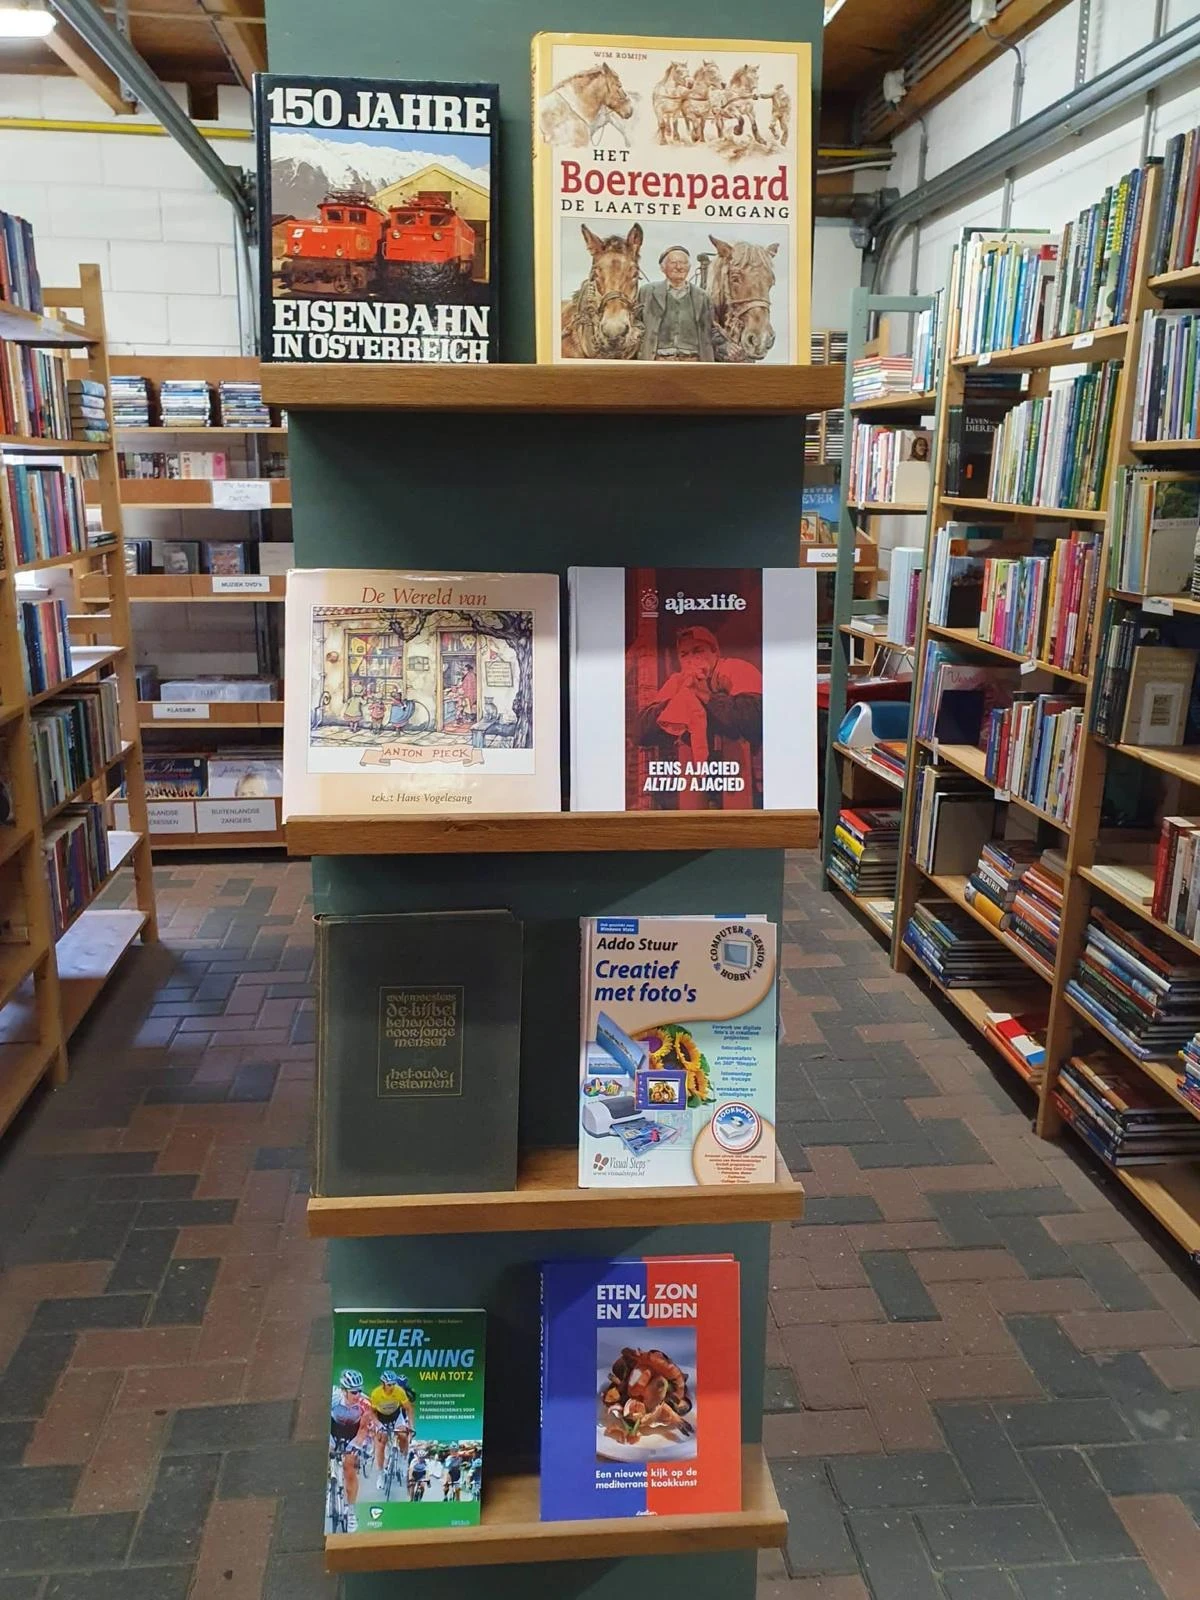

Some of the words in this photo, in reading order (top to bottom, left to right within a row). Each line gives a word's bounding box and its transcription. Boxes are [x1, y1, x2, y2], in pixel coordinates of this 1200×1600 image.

[594, 51, 613, 59] WIM
[616, 52, 648, 61] ROMIJN
[267, 87, 342, 127] 150
[348, 91, 490, 134] JAHRE
[593, 150, 630, 162] HET
[560, 160, 789, 210] Boerenpaard
[561, 199, 584, 212] DE
[595, 200, 682, 215] LAATSTE
[704, 204, 790, 218] OMGANG
[272, 300, 491, 337] EISENBAHN
[272, 333, 304, 358] IN
[308, 332, 489, 363] ÖSTERREICH
[362, 587, 385, 604] De
[393, 588, 452, 606] Wereld
[459, 594, 488, 606] van
[665, 592, 746, 614] ajaxlife
[383, 748, 423, 758] ANTON
[432, 748, 469, 759] PIECK
[648, 761, 682, 776] EENS
[685, 761, 740, 776] AJACIED
[643, 778, 687, 792] ALTIJD
[690, 778, 745, 792] AJACIED
[396, 792, 420, 803] Hans
[424, 792, 473, 805] Vogelesang
[744, 928, 752, 937] &
[597, 937, 635, 950] Addo
[639, 938, 678, 952] Stuur
[711, 925, 744, 962] COMPUTER
[751, 934, 765, 968] SENIOR
[596, 960, 680, 979] Creatief
[720, 969, 752, 981] HOBBY
[595, 984, 636, 1002] met
[640, 983, 697, 1002] foto's
[394, 1036, 448, 1048] mensen
[386, 1072, 454, 1089] testament
[610, 1157, 628, 1169] Visual
[630, 1157, 646, 1172] Steps
[596, 1284, 646, 1302] ETEN,
[654, 1284, 698, 1300] ZON
[596, 1304, 622, 1320] EN
[628, 1303, 698, 1320] ZUIDEN
[348, 1328, 430, 1347] WIELER-
[376, 1349, 476, 1368] TRAINING
[420, 1371, 439, 1381] VAN
[441, 1371, 447, 1381] A
[449, 1371, 465, 1381] TOT
[466, 1371, 474, 1381] Z
[596, 1470, 612, 1478] Een
[614, 1470, 648, 1478] nieuwe
[651, 1468, 668, 1478] kijk
[672, 1470, 683, 1479] op
[686, 1468, 698, 1476] de
[596, 1480, 648, 1489] mediterrane
[651, 1478, 698, 1488] kookkunst
